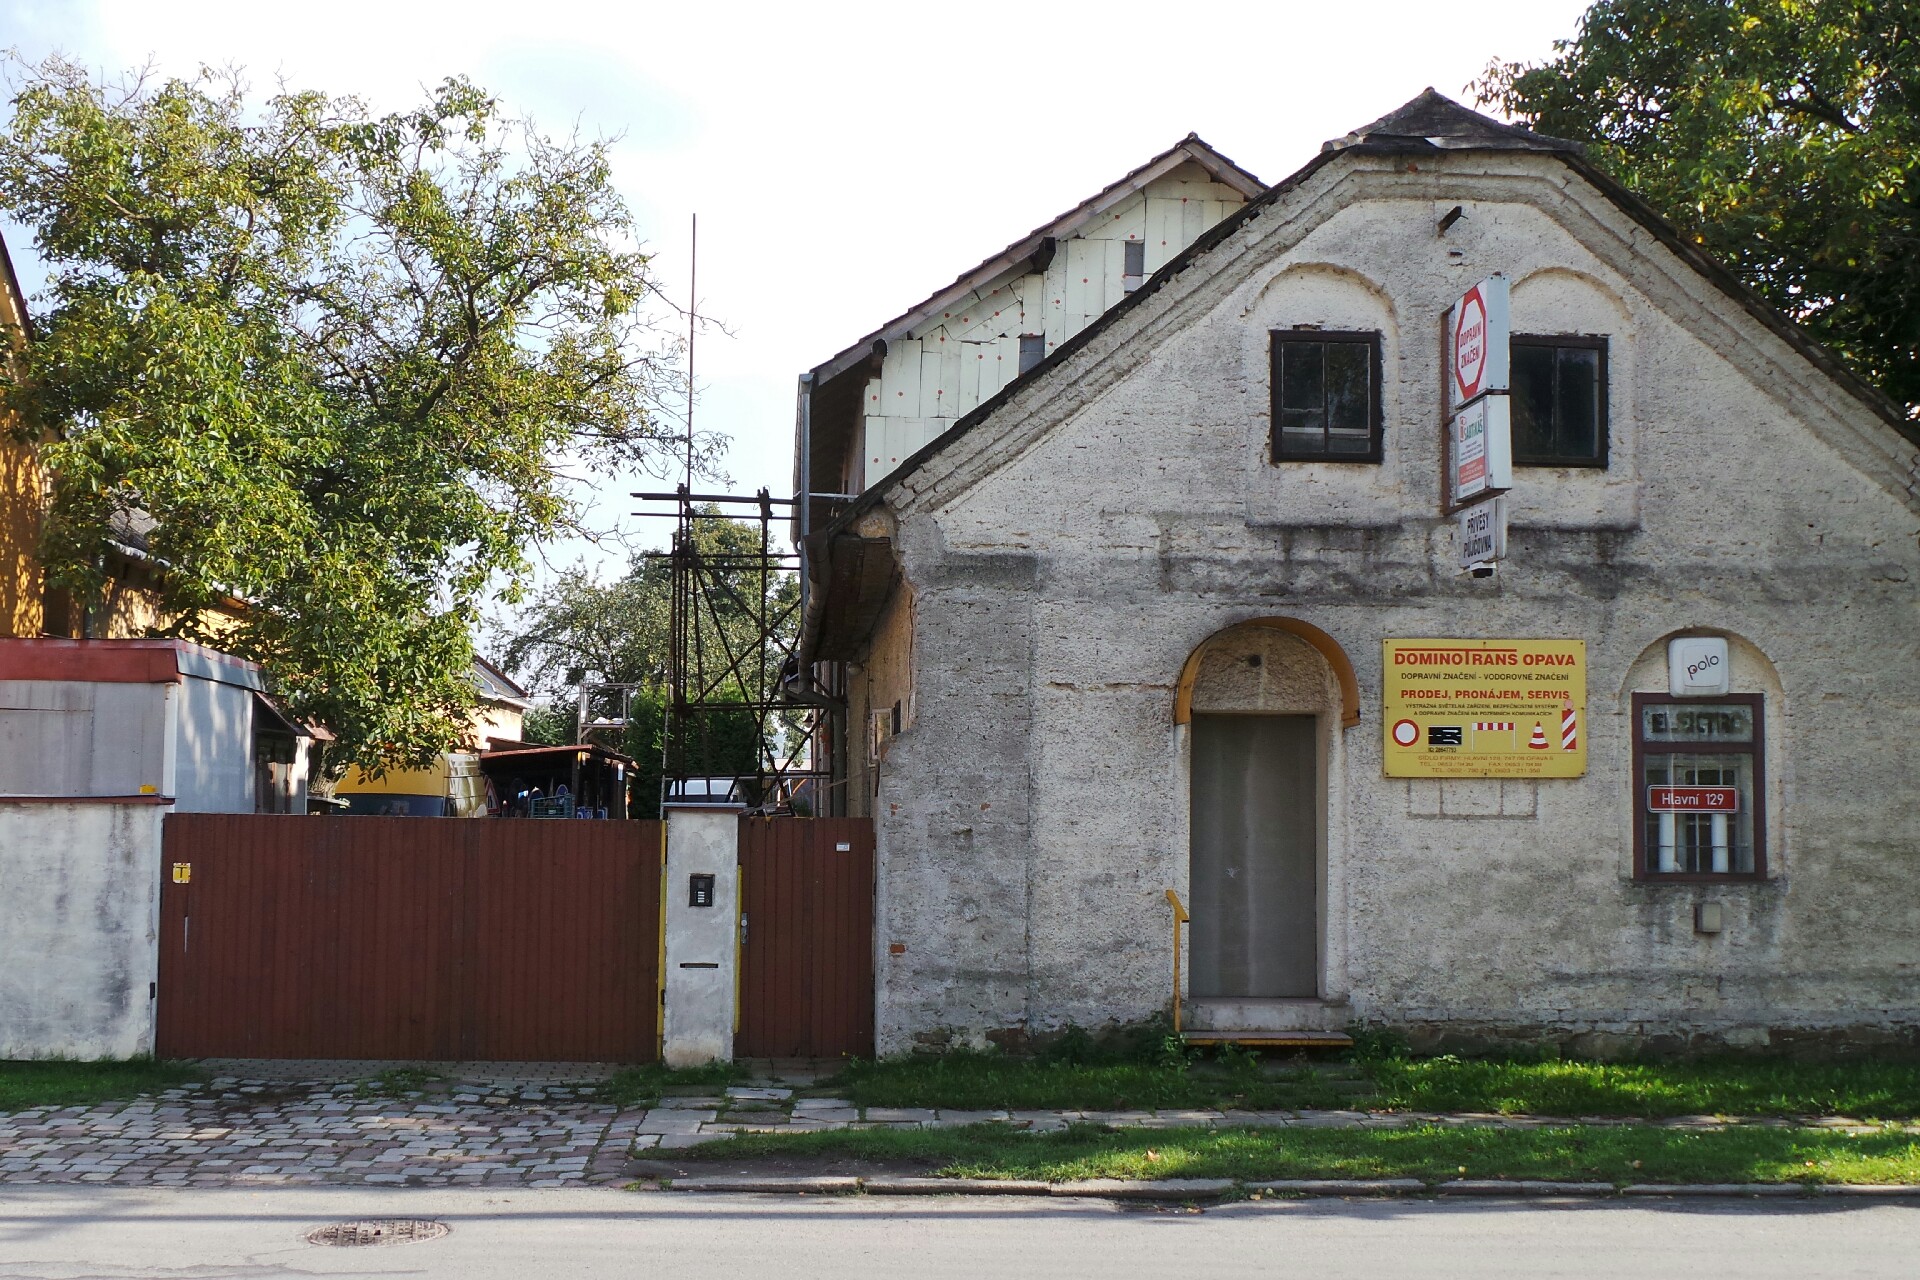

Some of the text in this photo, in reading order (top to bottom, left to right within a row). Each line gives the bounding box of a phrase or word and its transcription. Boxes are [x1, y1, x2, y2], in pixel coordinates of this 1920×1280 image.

[1460, 316, 1481, 348] DOPRAVNÍ
[1461, 340, 1480, 368] ZNAČENÍ
[1467, 510, 1490, 535] PŘÍVĚSY
[1463, 535, 1491, 558] PŮJČOVNA
[1394, 648, 1576, 666] DOMINOTRANS OPAVA
[1401, 672, 1441, 680] DOPRAVNÍ
[1443, 672, 1477, 680] ZNAČENÍ
[1484, 672, 1533, 681] VODOROVNÉ
[1535, 673, 1569, 681] ZNAČENÍ
[1687, 654, 1719, 681] polo
[1401, 688, 1570, 700] PRODEJ, PRONÁJEM, SERVIS
[1661, 792, 1725, 806] Hlavní 129
[175, 866, 188, 879] T
